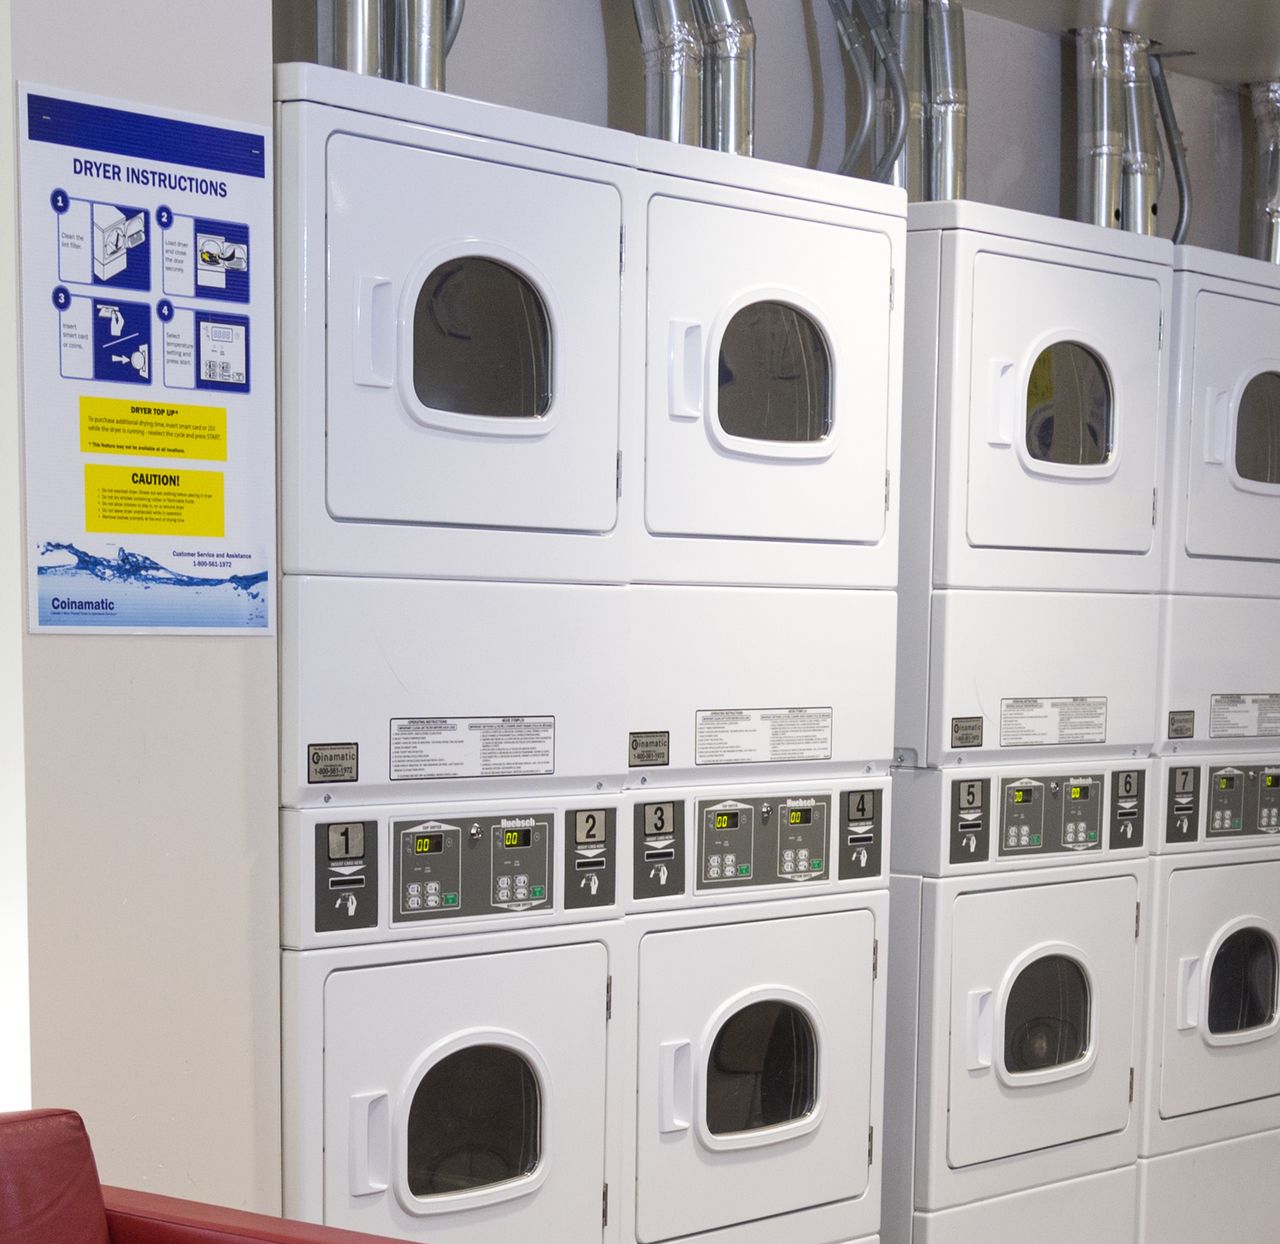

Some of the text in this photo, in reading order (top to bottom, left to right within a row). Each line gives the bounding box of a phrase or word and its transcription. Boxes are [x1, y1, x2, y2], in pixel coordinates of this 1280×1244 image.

[73, 158, 227, 198] DRYER INSTRUCTIONS
[57, 196, 64, 206] 1
[161, 212, 168, 222] 2
[61, 232, 75, 240] Clean
[58, 293, 65, 303] 3
[162, 306, 168, 316] 4
[166, 341, 194, 350] temperature
[130, 406, 152, 415] DRYER
[153, 408, 165, 416] TOP
[132, 472, 180, 486] CAUTION!
[52, 597, 114, 610] Coinamatic
[1124, 774, 1132, 794] 6
[1181, 771, 1189, 790] 7
[967, 784, 975, 805] 5
[856, 794, 866, 817] 4
[501, 818, 535, 828] Huebsch
[654, 806, 664, 831] 3
[716, 816, 728, 828] 00
[790, 812, 801, 823] 00
[586, 814, 596, 839] 2
[340, 828, 349, 854] 1
[416, 838, 429, 852] 00
[505, 832, 518, 845] 00
